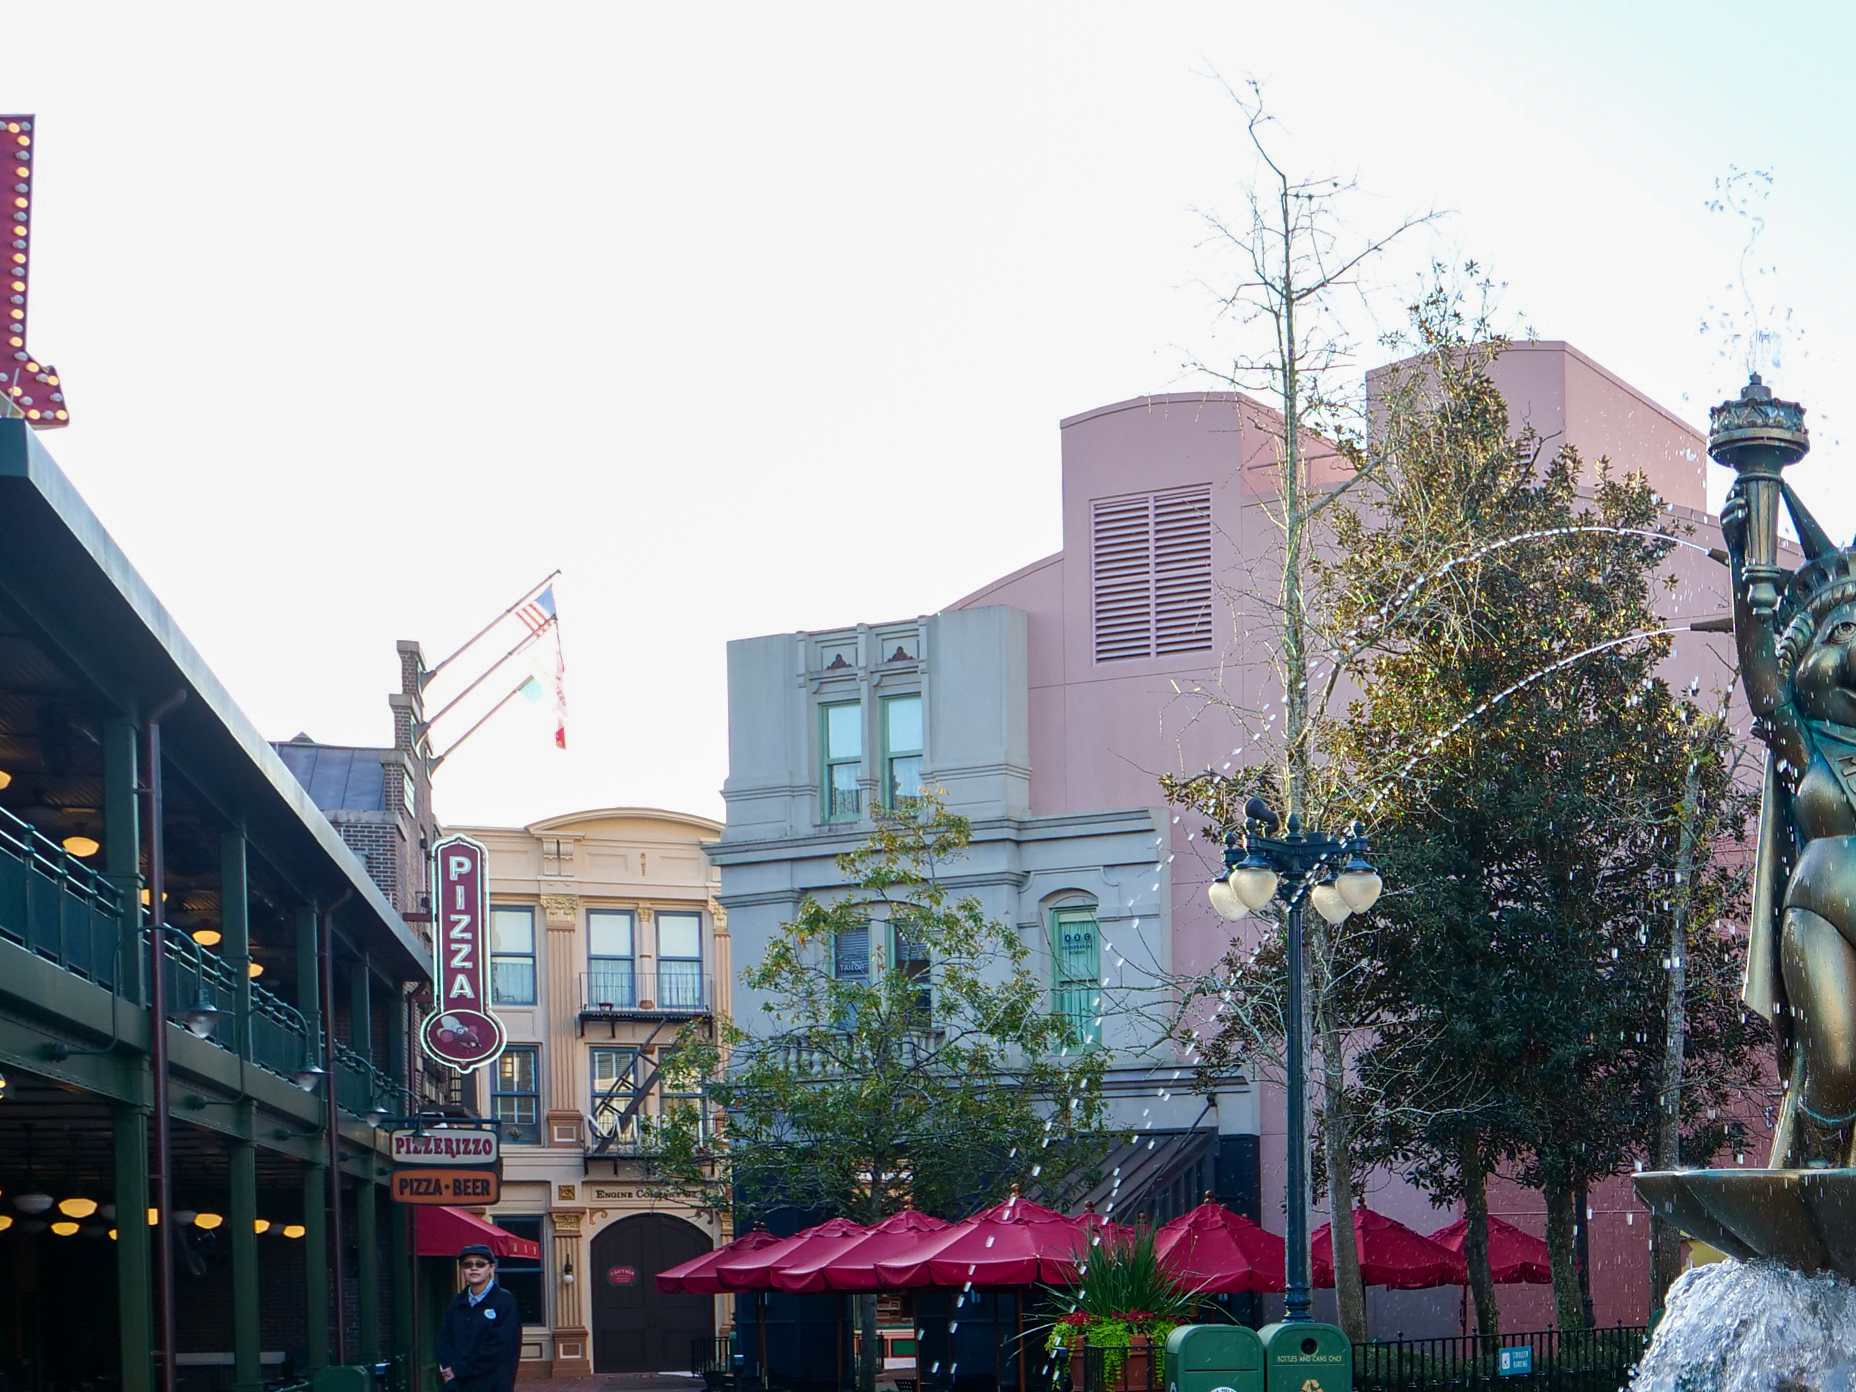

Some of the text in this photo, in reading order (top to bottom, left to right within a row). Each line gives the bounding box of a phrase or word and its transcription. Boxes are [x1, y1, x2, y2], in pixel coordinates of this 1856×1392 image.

[449, 856, 475, 998] PIZZA
[395, 1136, 493, 1158] PIZZERIZZO
[399, 1178, 491, 1196] PIZZA BEER
